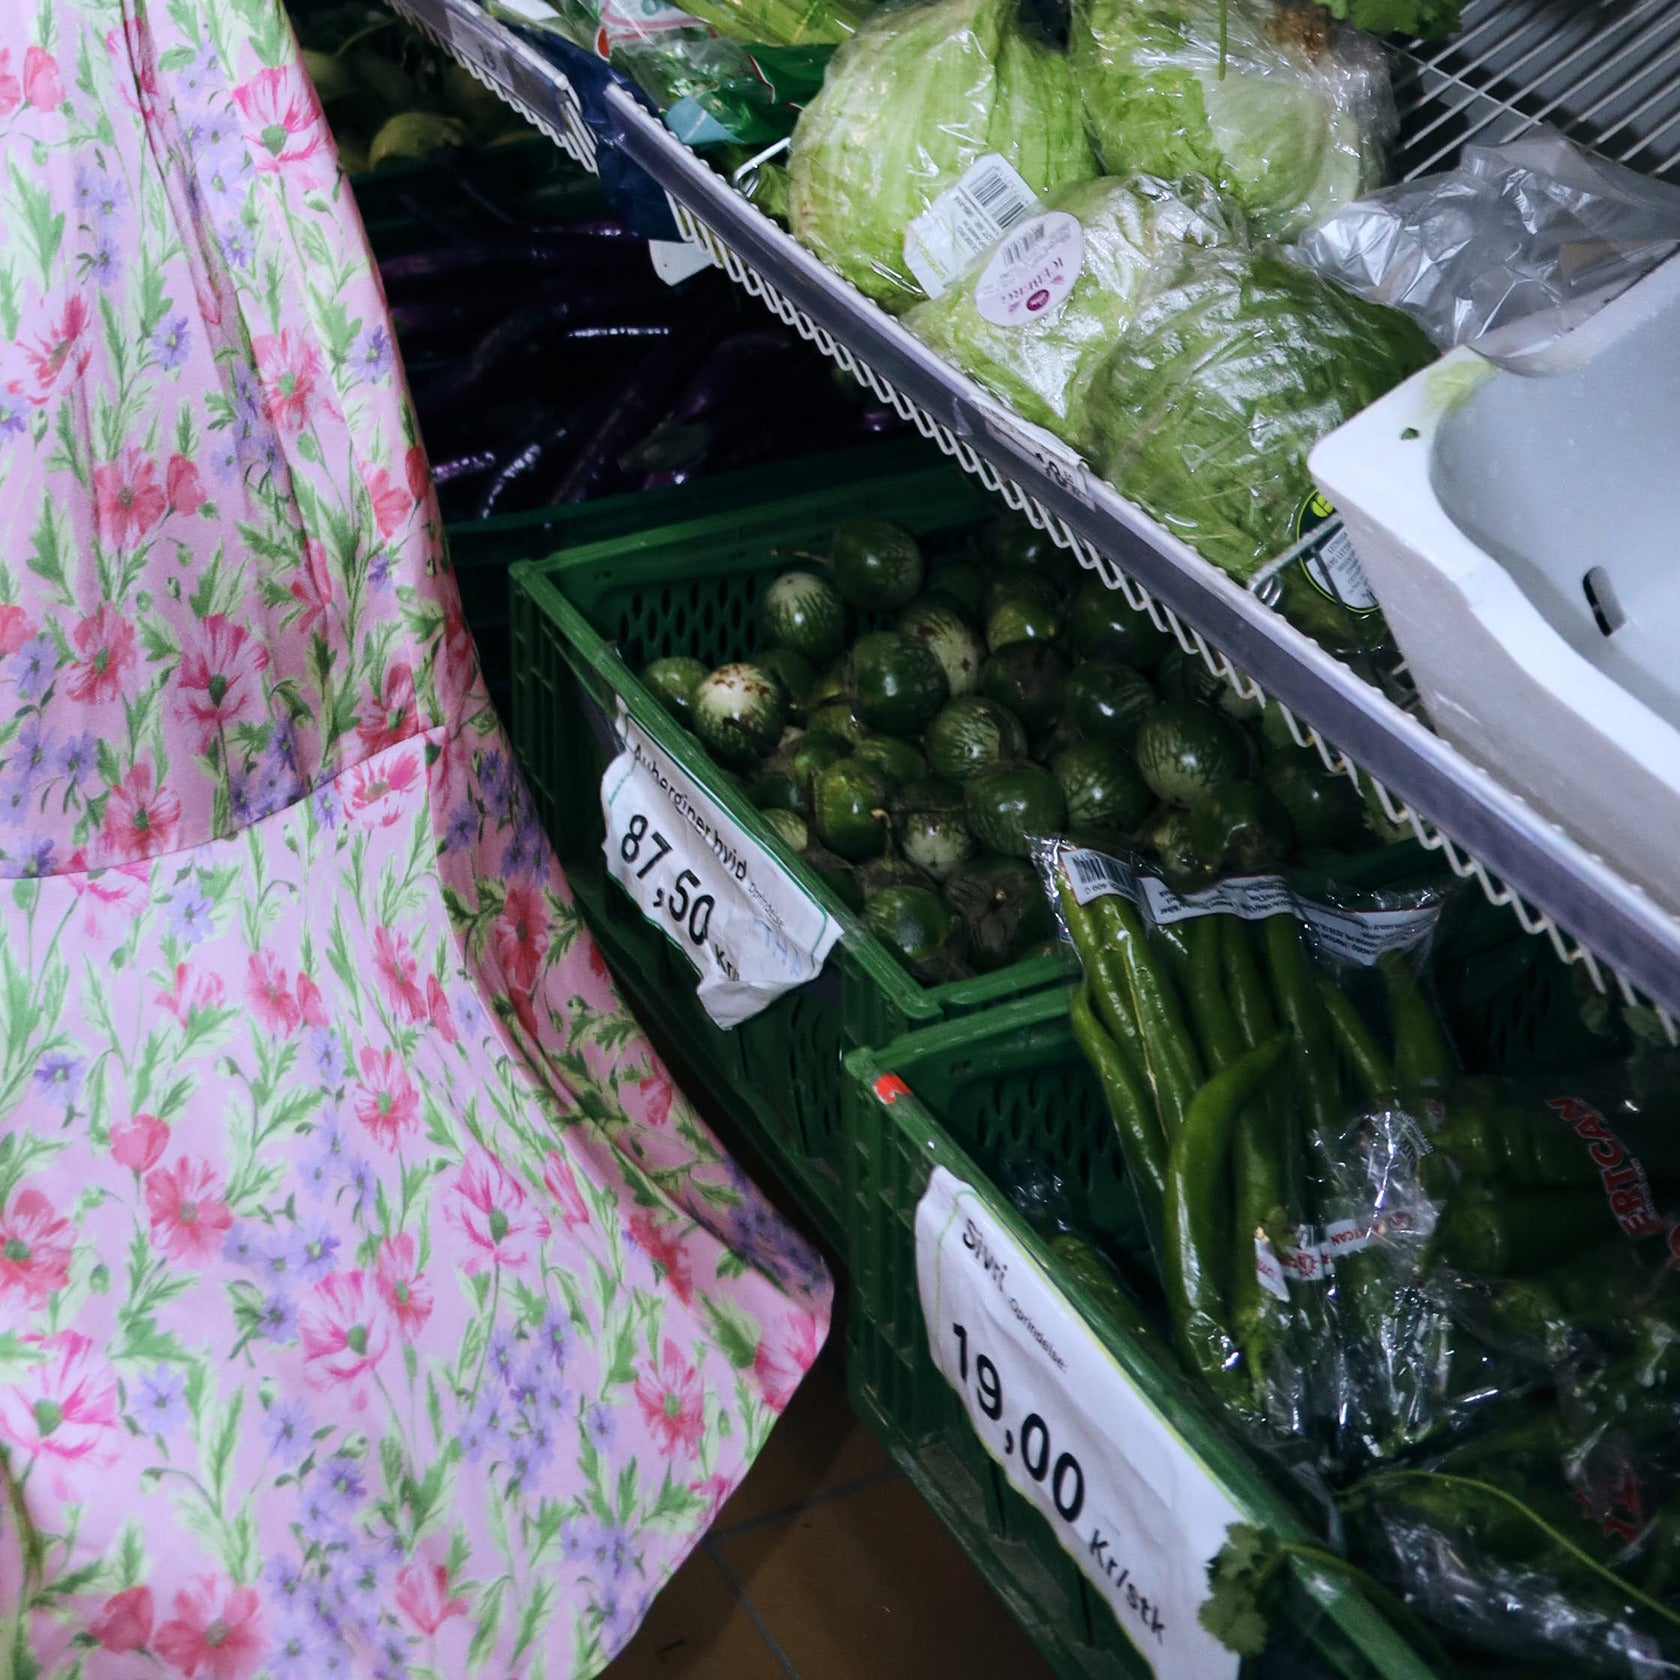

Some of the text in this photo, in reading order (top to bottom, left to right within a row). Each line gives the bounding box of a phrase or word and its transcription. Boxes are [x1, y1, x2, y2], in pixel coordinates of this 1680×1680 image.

[620, 814, 715, 946] 87,50
[711, 830, 748, 882] hvid
[1544, 1096, 1665, 1237] ERTCAN
[952, 1322, 1086, 1524] 19,00
[1088, 1528, 1166, 1644] Kr/stk
